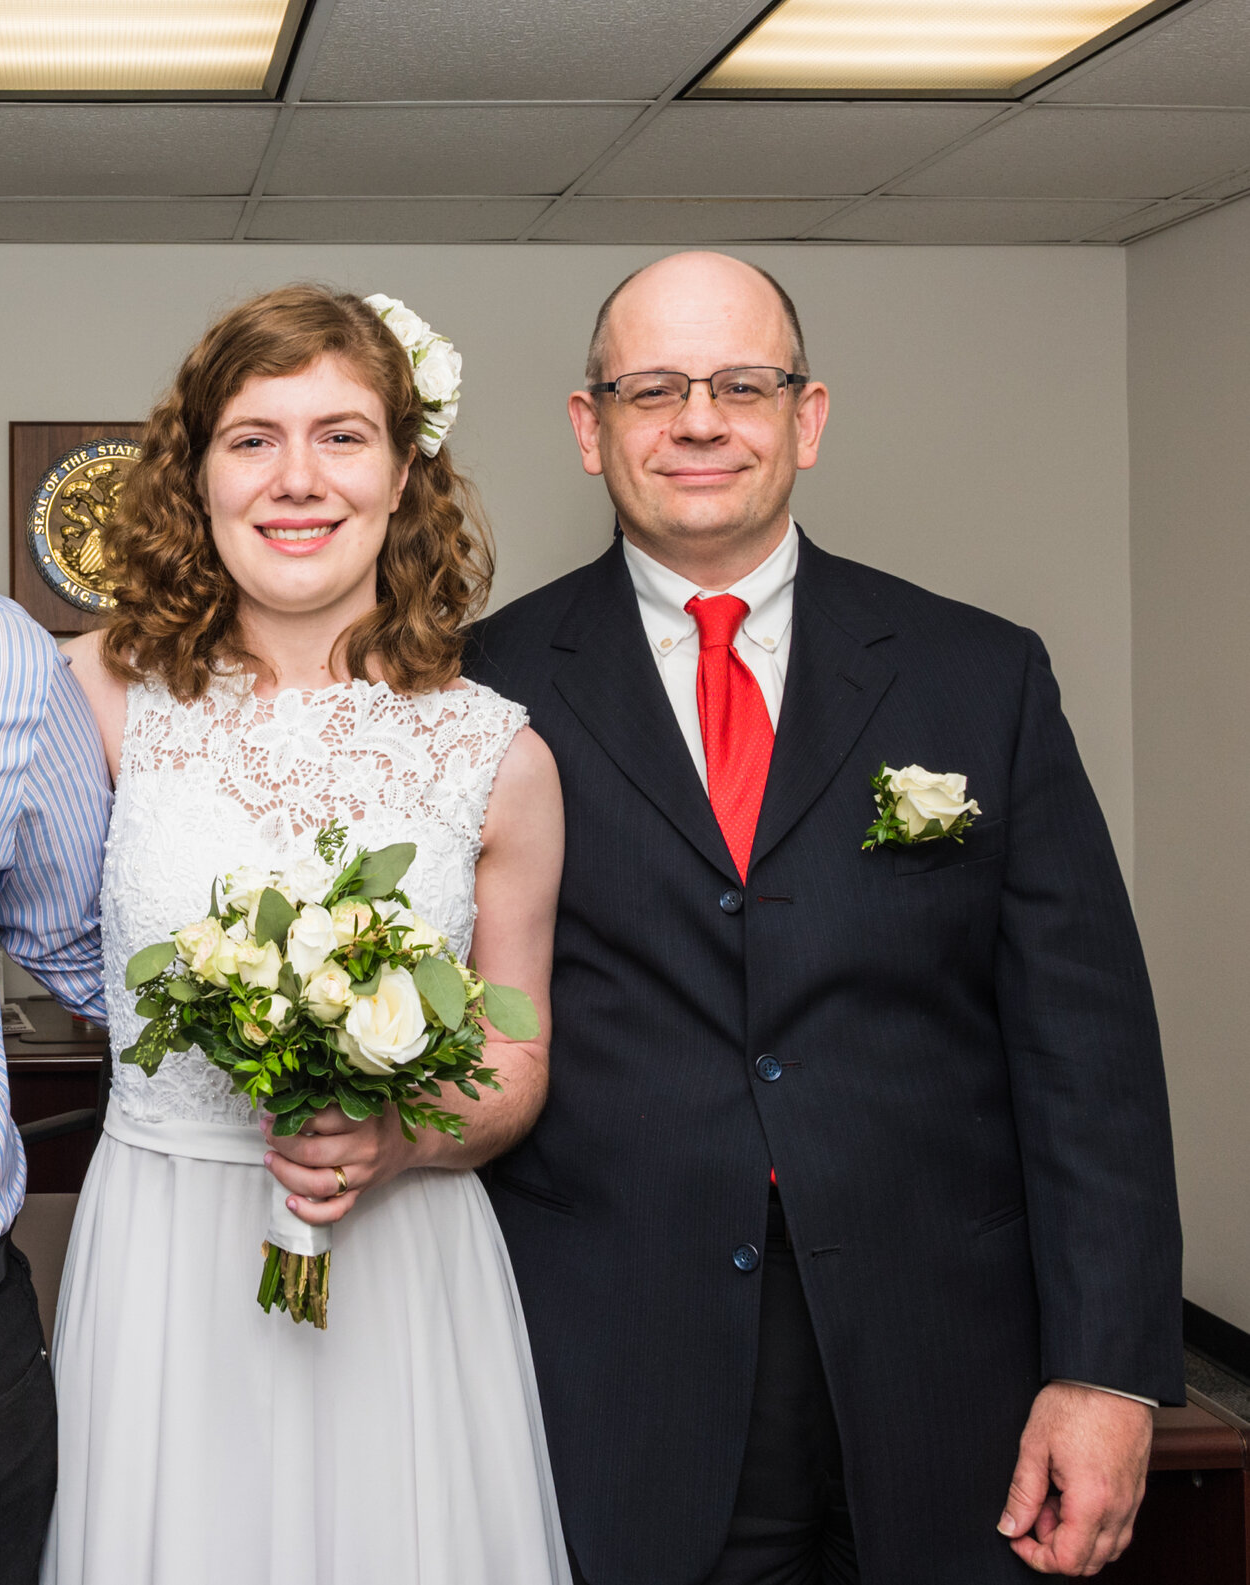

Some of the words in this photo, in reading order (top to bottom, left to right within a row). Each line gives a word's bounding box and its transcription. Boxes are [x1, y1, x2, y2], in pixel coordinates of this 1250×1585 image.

[34, 497, 49, 535] SEAL
[45, 472, 60, 492] OF
[61, 451, 90, 472] THE
[97, 444, 142, 458] STATE
[60, 580, 92, 603] AUG.
